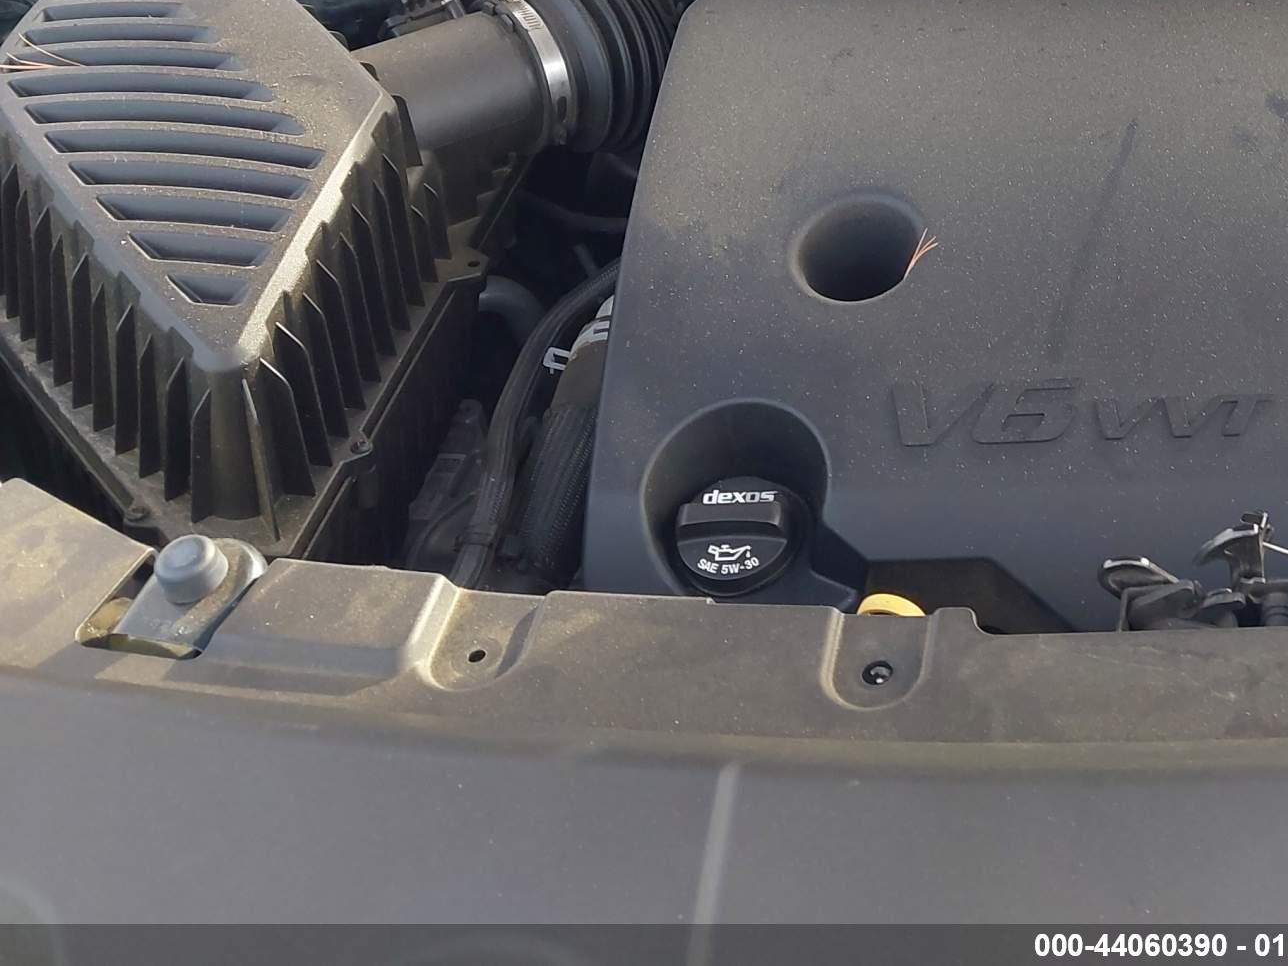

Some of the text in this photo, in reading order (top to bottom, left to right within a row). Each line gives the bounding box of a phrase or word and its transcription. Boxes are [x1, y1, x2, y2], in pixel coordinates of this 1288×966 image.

[890, 377, 1081, 447] V6
[702, 489, 778, 505] dexos
[697, 557, 760, 575] SAE 5W-30
